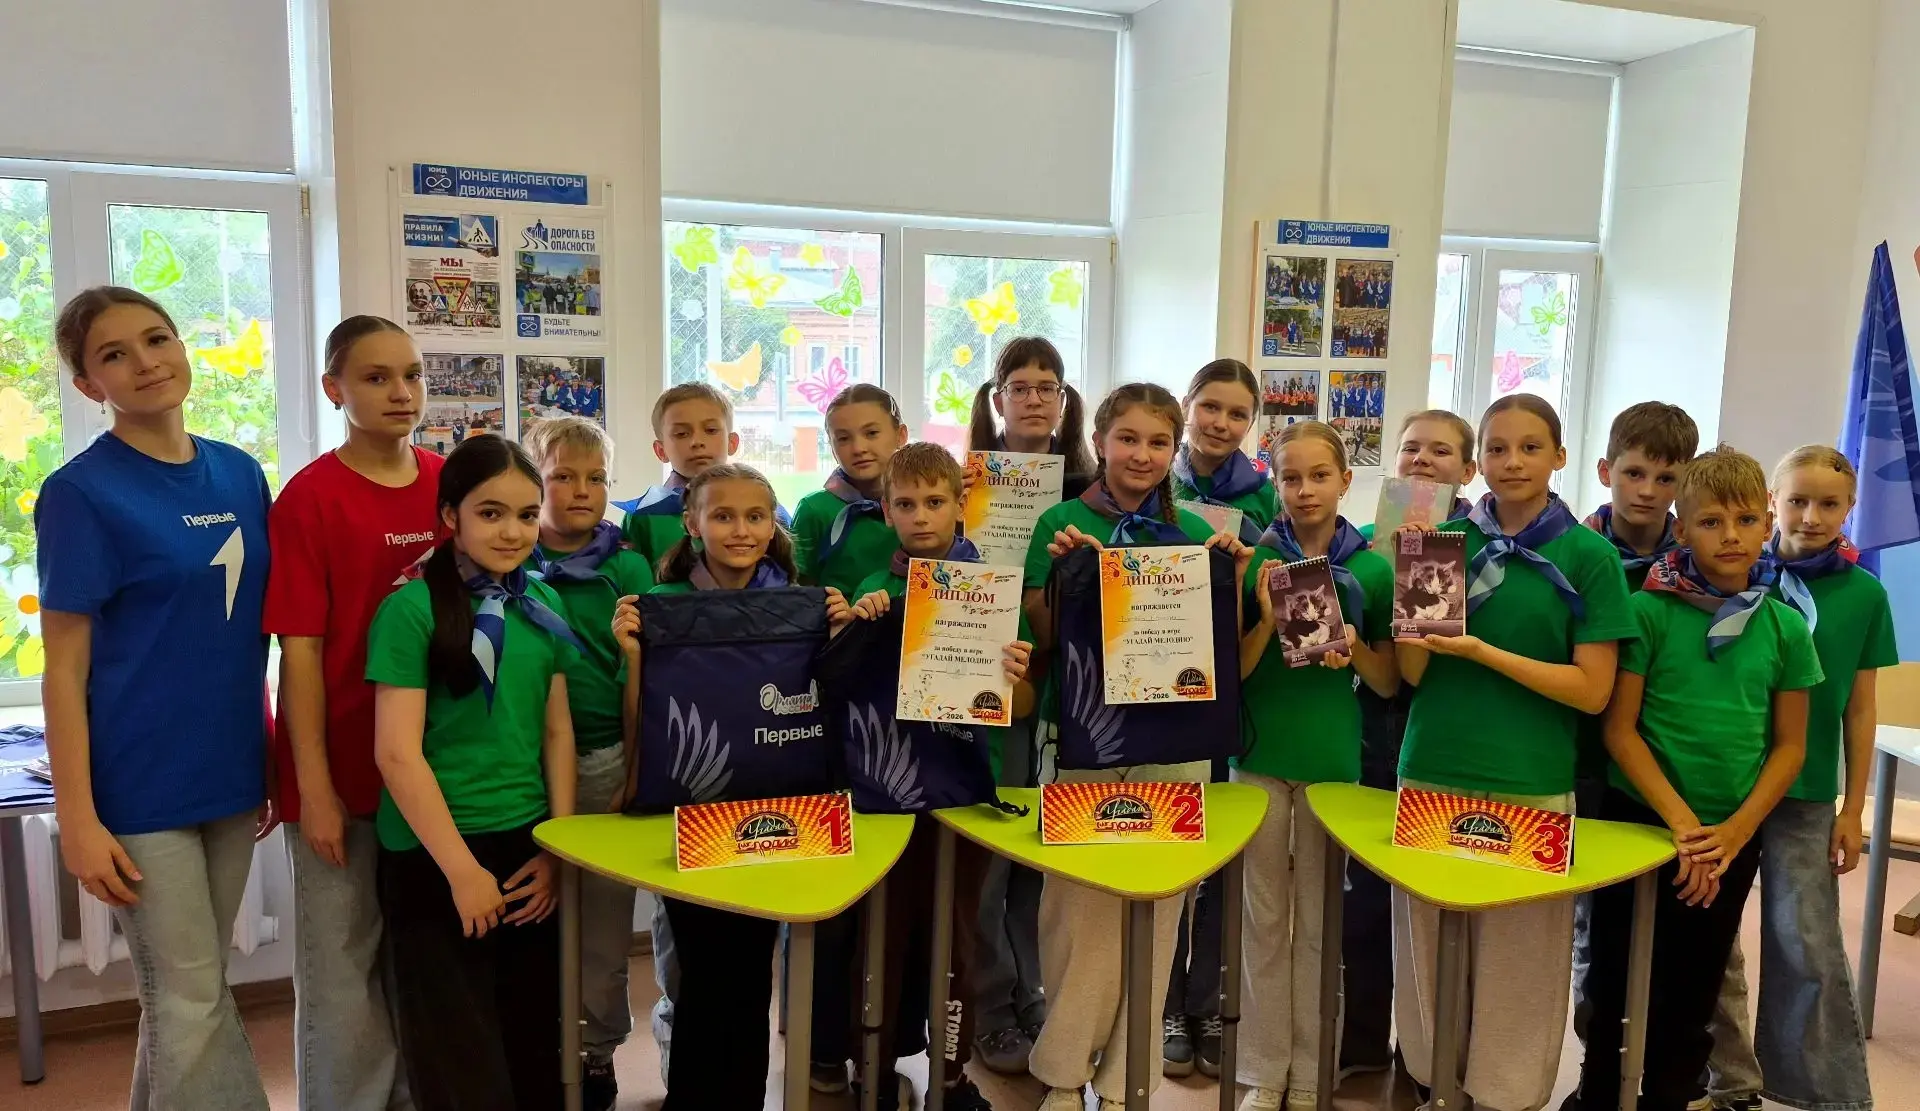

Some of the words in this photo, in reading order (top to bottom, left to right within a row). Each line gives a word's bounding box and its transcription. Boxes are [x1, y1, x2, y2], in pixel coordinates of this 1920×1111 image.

[460, 170, 500, 183] ЮНЫЕ
[502, 173, 584, 188] ИНСПЕКТОРЫ
[459, 185, 528, 199] ДВИЖЕНИЯ
[404, 223, 444, 232] ПРАВИЛА
[1307, 222, 1334, 232] ЮНЫЕ
[1335, 224, 1388, 234] ИНСПЕКТОРЫ
[405, 233, 444, 242] ЖИЗНИ!
[550, 228, 580, 240] ДОРОГА
[581, 230, 595, 240] БЕЗ
[1306, 234, 1351, 245] ДВИЖЕНИЯ
[550, 241, 596, 252] ОПАСНОСТИ
[440, 257, 464, 267] МЫ
[544, 318, 571, 326] БУДЬТЕ
[983, 476, 1040, 488] ДИПЛОМ
[181, 512, 237, 529] Первые
[384, 531, 434, 548] Первые
[1121, 573, 1185, 588] ДИПЛОМ
[928, 588, 996, 604] ДИПЛОМ
[1131, 602, 1181, 612] награждается
[935, 619, 987, 630] награждается
[754, 723, 824, 747] Первые
[1170, 794, 1201, 833] 2
[818, 806, 844, 849] 1
[1531, 823, 1567, 866] 3
